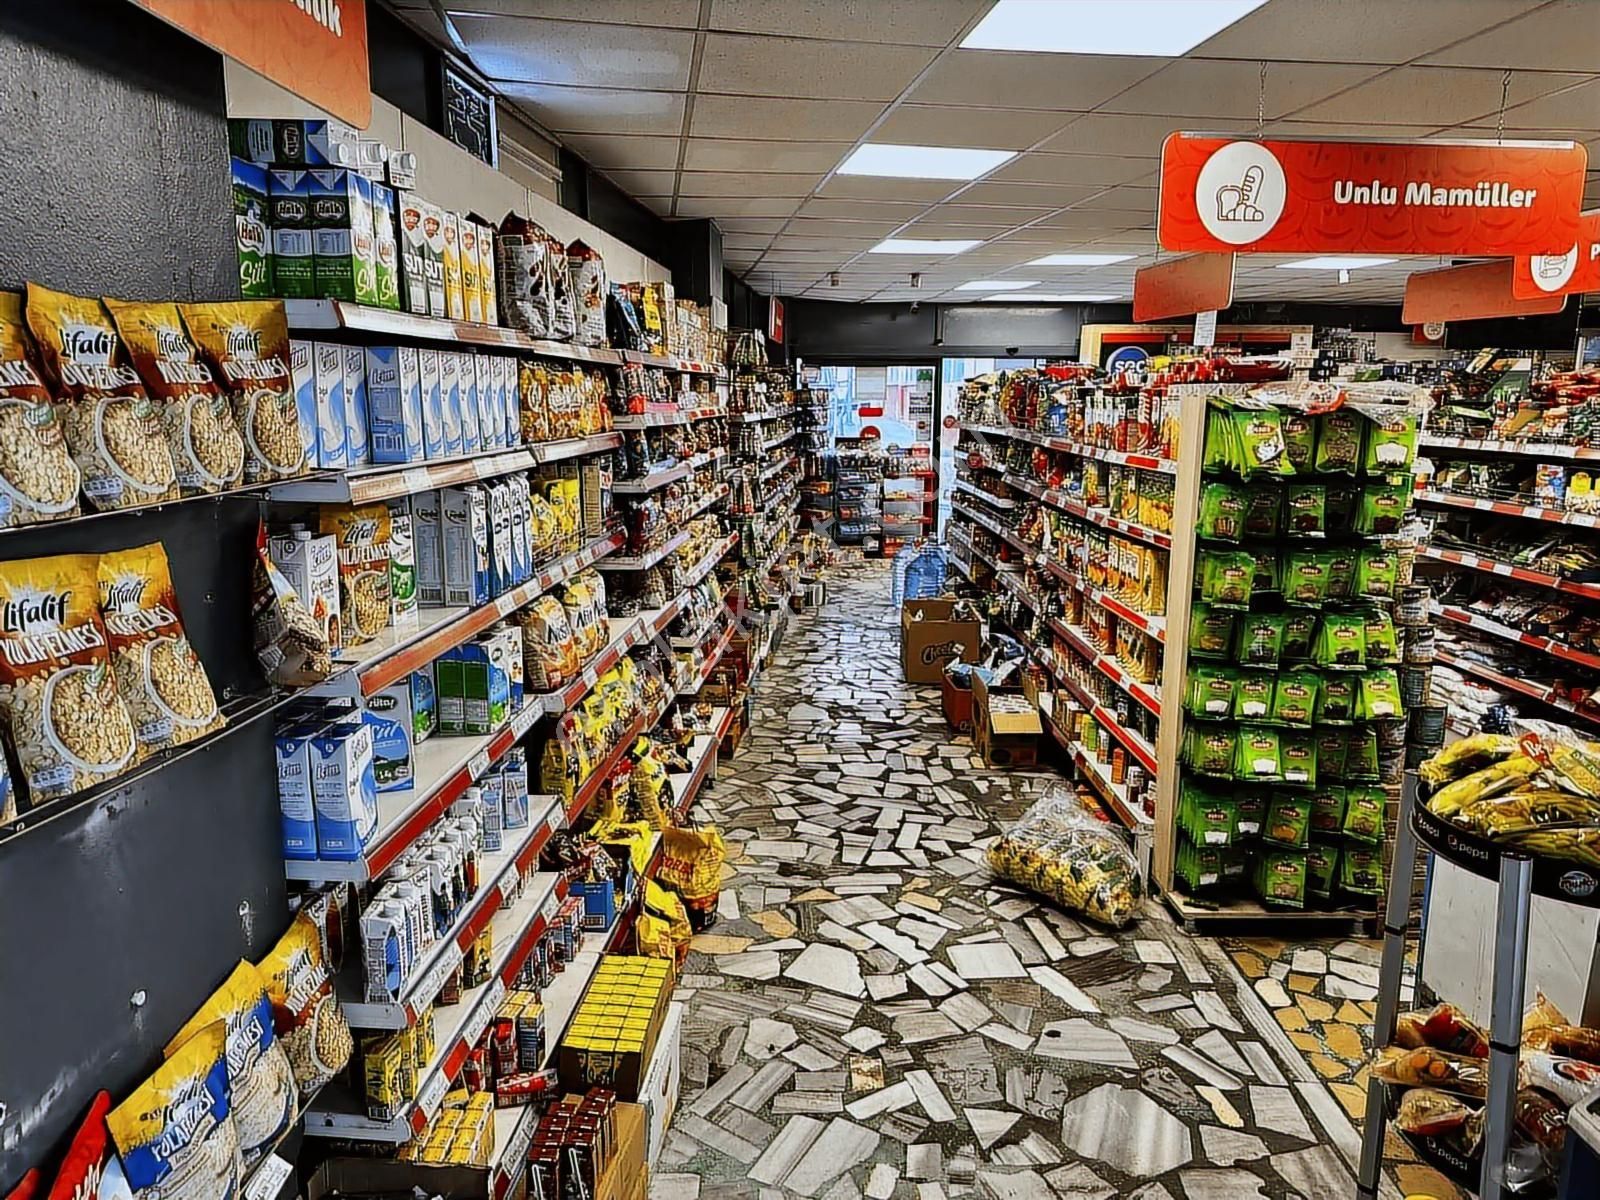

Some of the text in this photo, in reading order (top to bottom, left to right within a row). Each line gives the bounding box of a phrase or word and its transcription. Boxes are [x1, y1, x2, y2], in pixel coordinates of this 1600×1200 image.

[1333, 179, 1537, 209] Unlu Mamüller
[240, 260, 267, 288] Süt
[3, 590, 72, 633] Lifalif
[0, 617, 105, 666] YULAF EZMESİ
